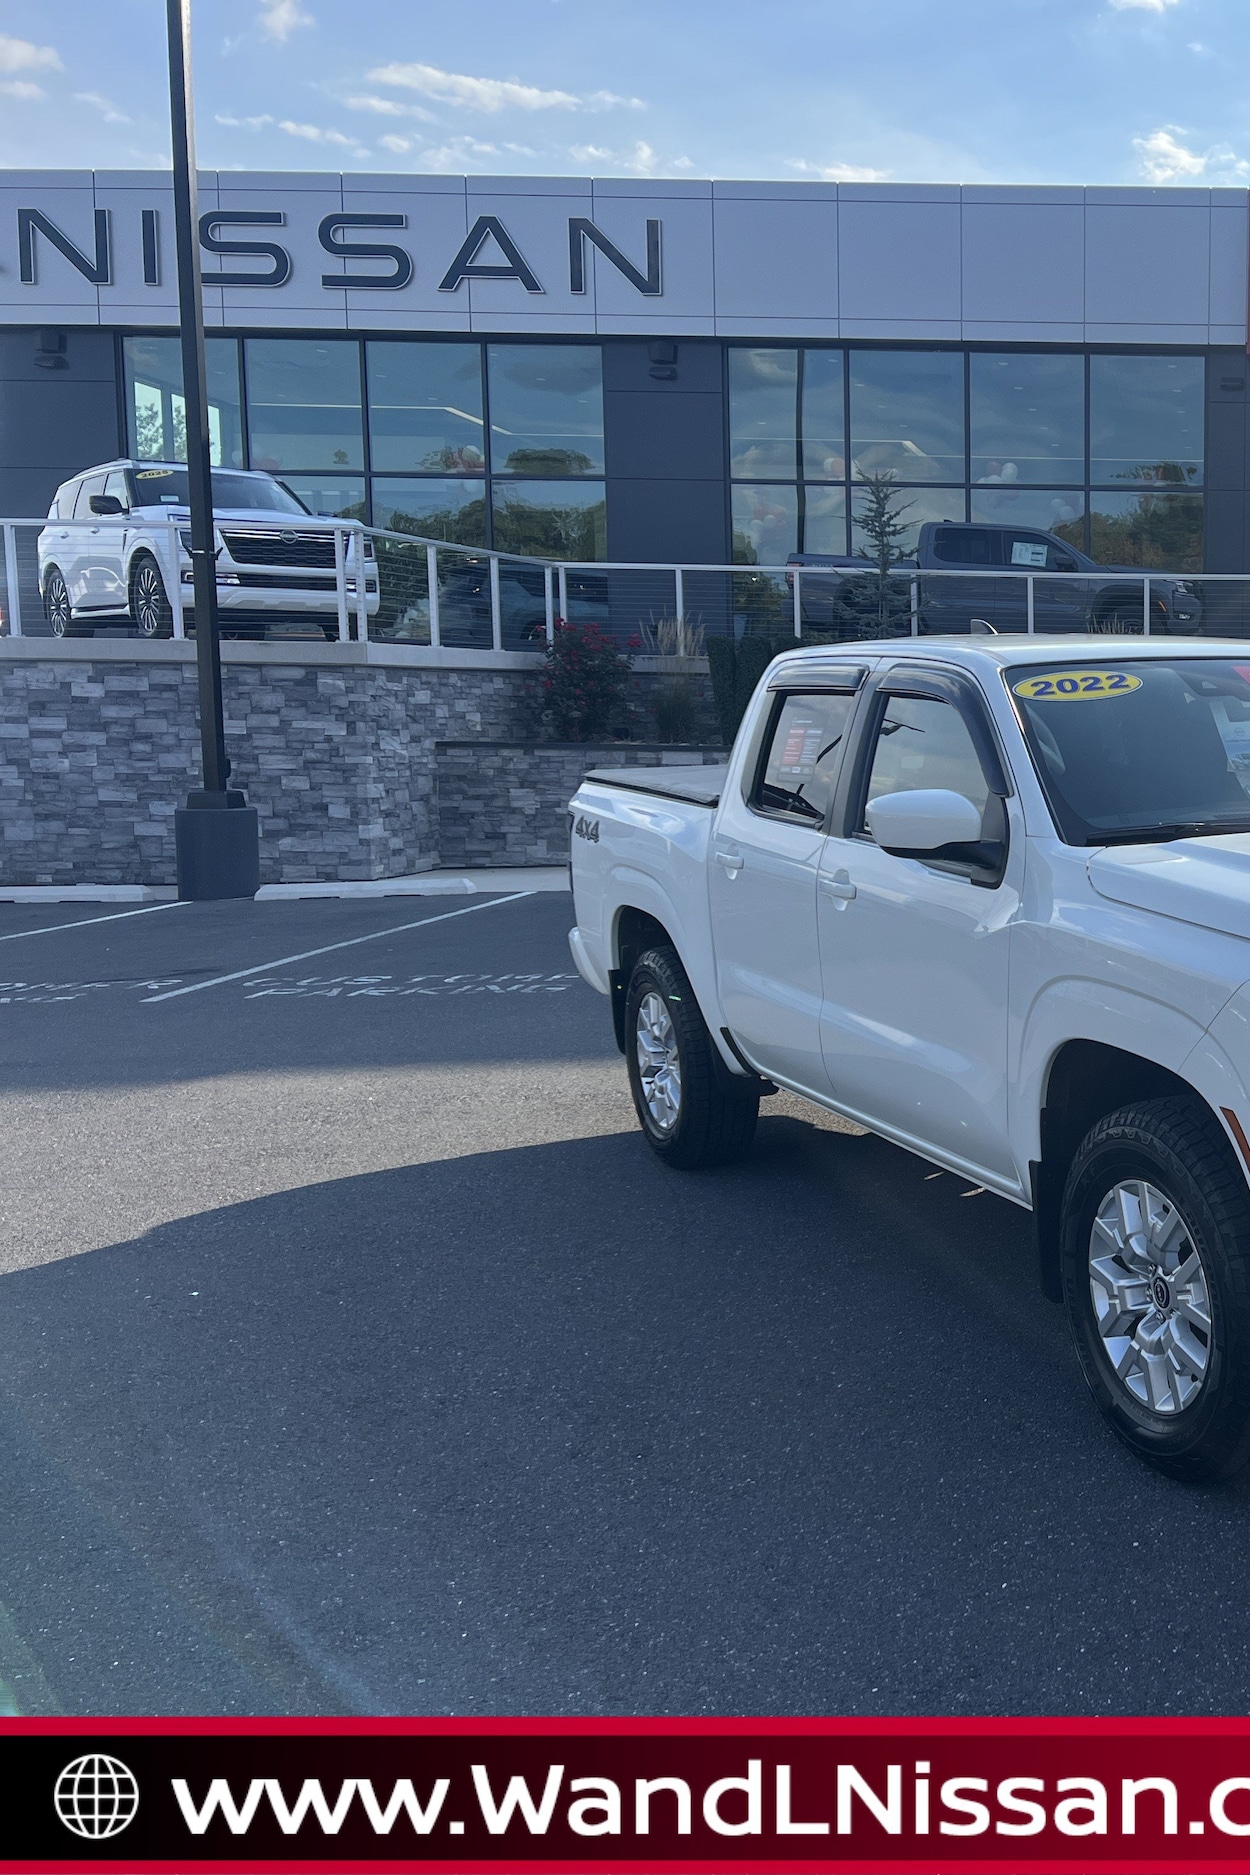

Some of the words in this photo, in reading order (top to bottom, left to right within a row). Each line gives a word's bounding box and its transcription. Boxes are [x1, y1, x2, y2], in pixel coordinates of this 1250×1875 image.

[17, 207, 664, 297] NISSAN
[1031, 674, 1131, 697] 2022
[244, 984, 573, 999] PARKING
